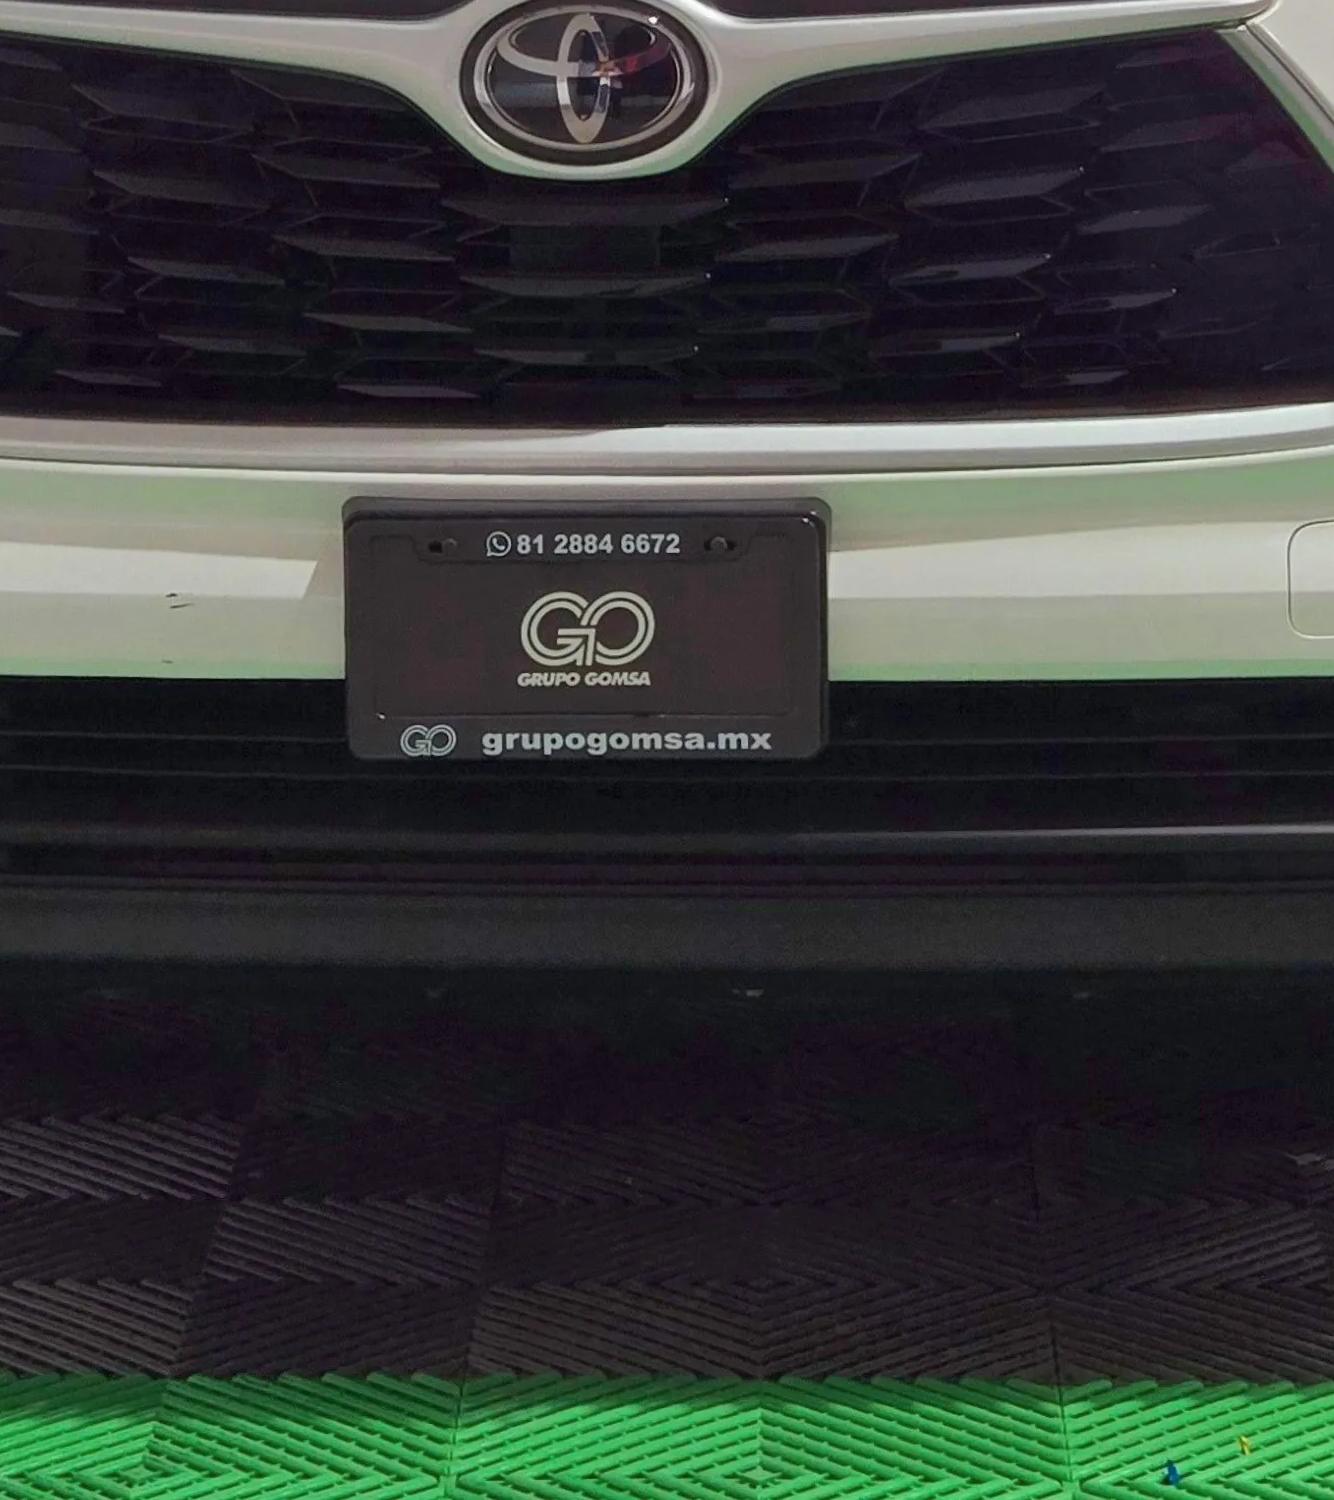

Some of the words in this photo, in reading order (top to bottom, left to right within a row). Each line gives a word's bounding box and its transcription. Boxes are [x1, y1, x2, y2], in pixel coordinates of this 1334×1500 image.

[517, 533, 545, 555] 81
[553, 533, 615, 555] 2884
[620, 533, 682, 555] 6672
[517, 672, 581, 688] GRUPO
[584, 671, 652, 687] GOMSA
[482, 731, 773, 756] grupogomsa.mx
